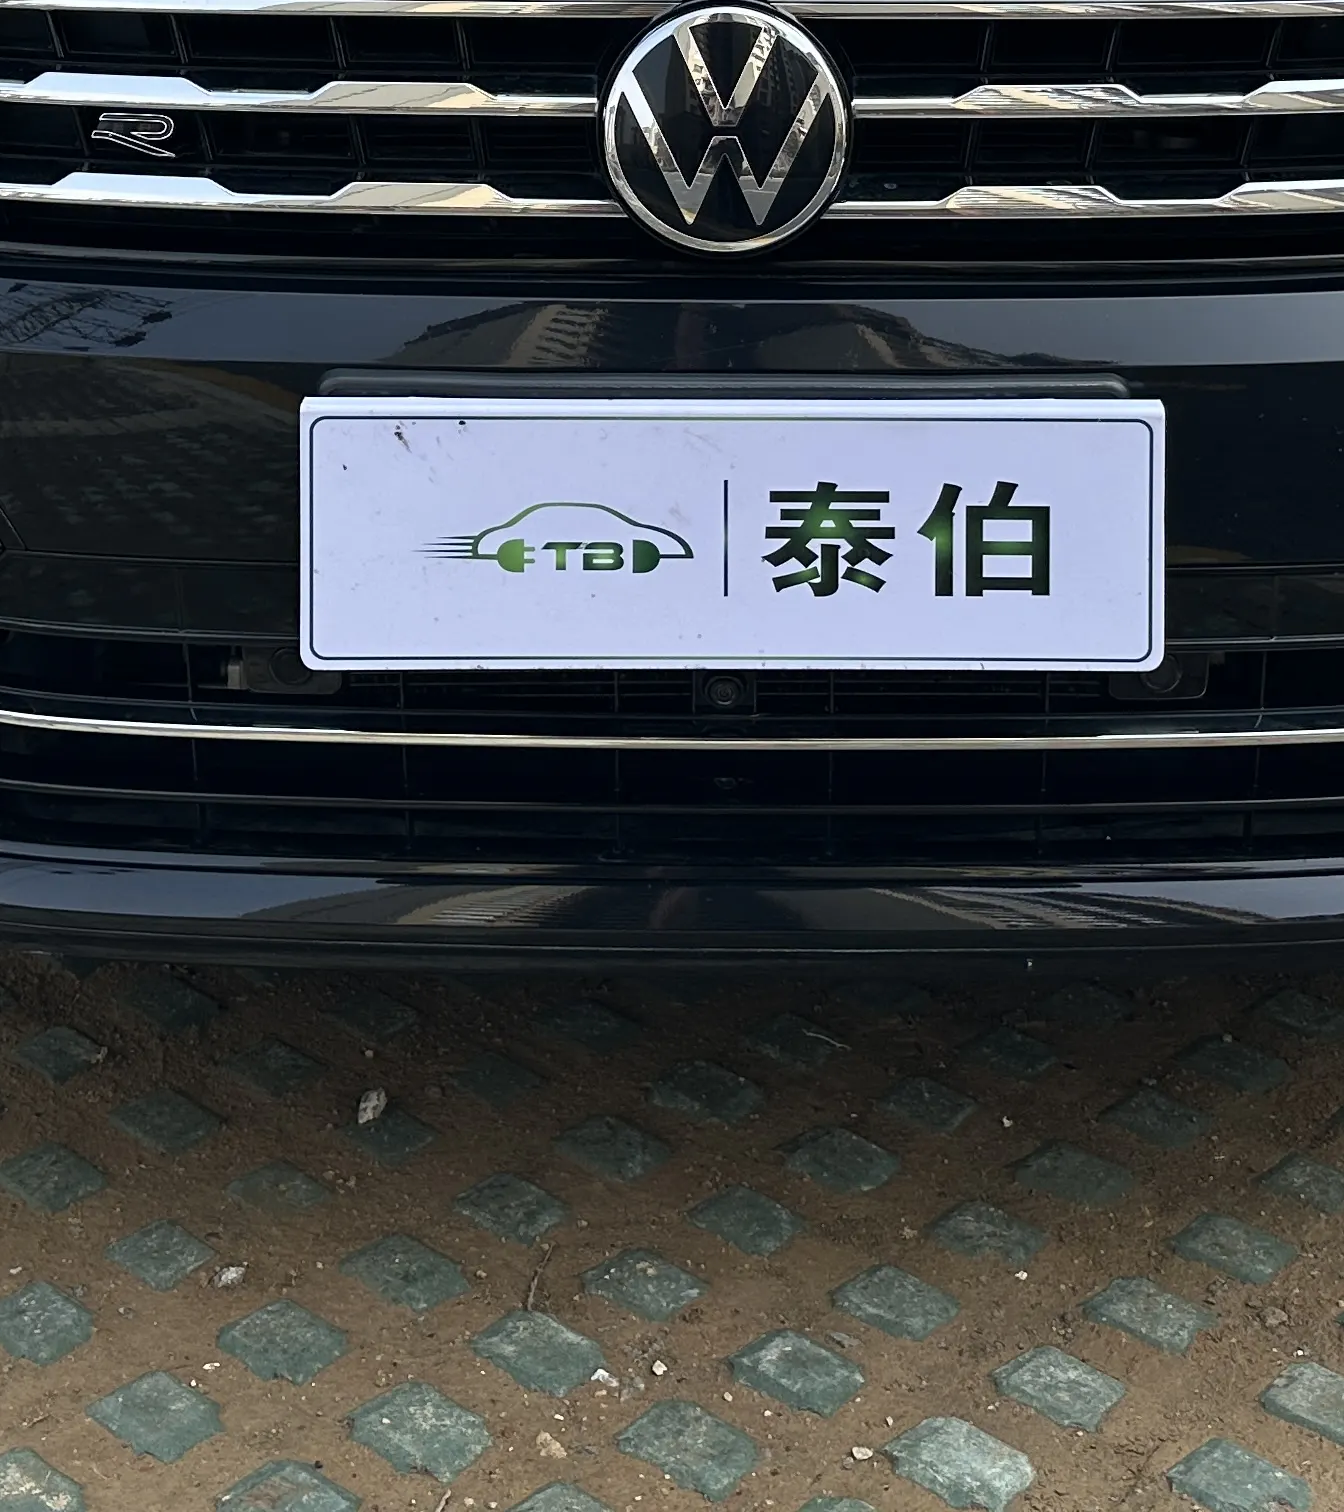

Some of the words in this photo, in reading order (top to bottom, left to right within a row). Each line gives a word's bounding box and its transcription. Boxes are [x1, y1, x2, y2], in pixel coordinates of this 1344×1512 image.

[91, 113, 176, 158] R
[612, 13, 840, 228] VW
[540, 541, 625, 571] TB
[761, 480, 1051, 597] 泰伯
